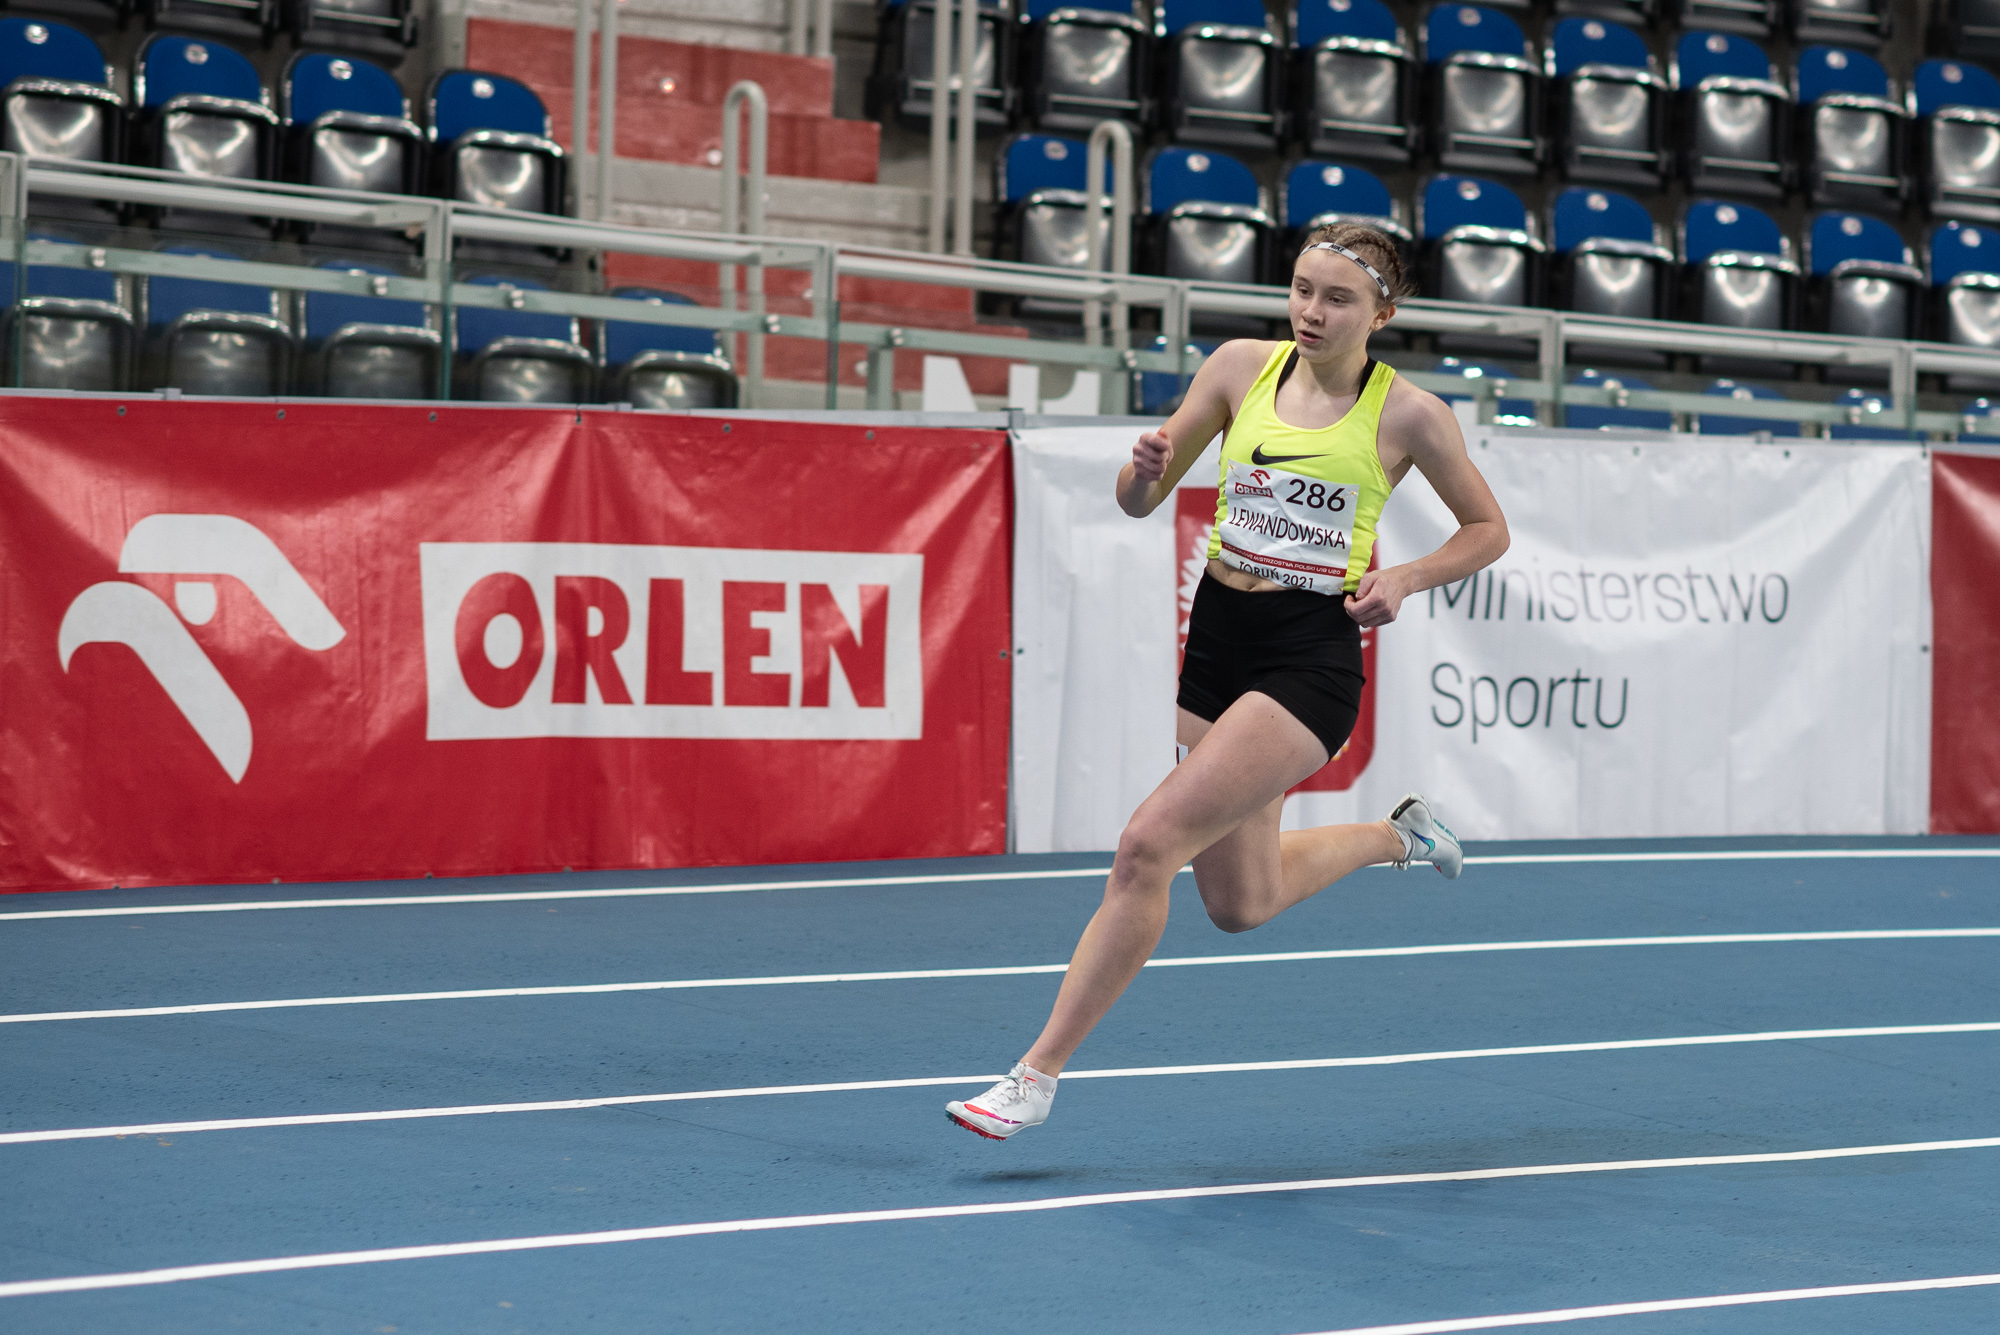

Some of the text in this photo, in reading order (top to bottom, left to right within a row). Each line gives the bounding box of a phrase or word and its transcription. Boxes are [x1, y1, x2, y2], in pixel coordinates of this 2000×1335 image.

[1236, 484, 1271, 496] ORLEN
[1285, 478, 1346, 512] 286
[1228, 507, 1345, 549] LEWANDOWSKA
[1253, 555, 1294, 568] MISTRZOSTWA
[1294, 563, 1316, 571] POLSKI
[1282, 573, 1314, 589] 2021
[1428, 555, 1790, 624] Ministerstwo
[454, 571, 890, 710] ORLEN
[1430, 662, 1629, 744] Sportu
